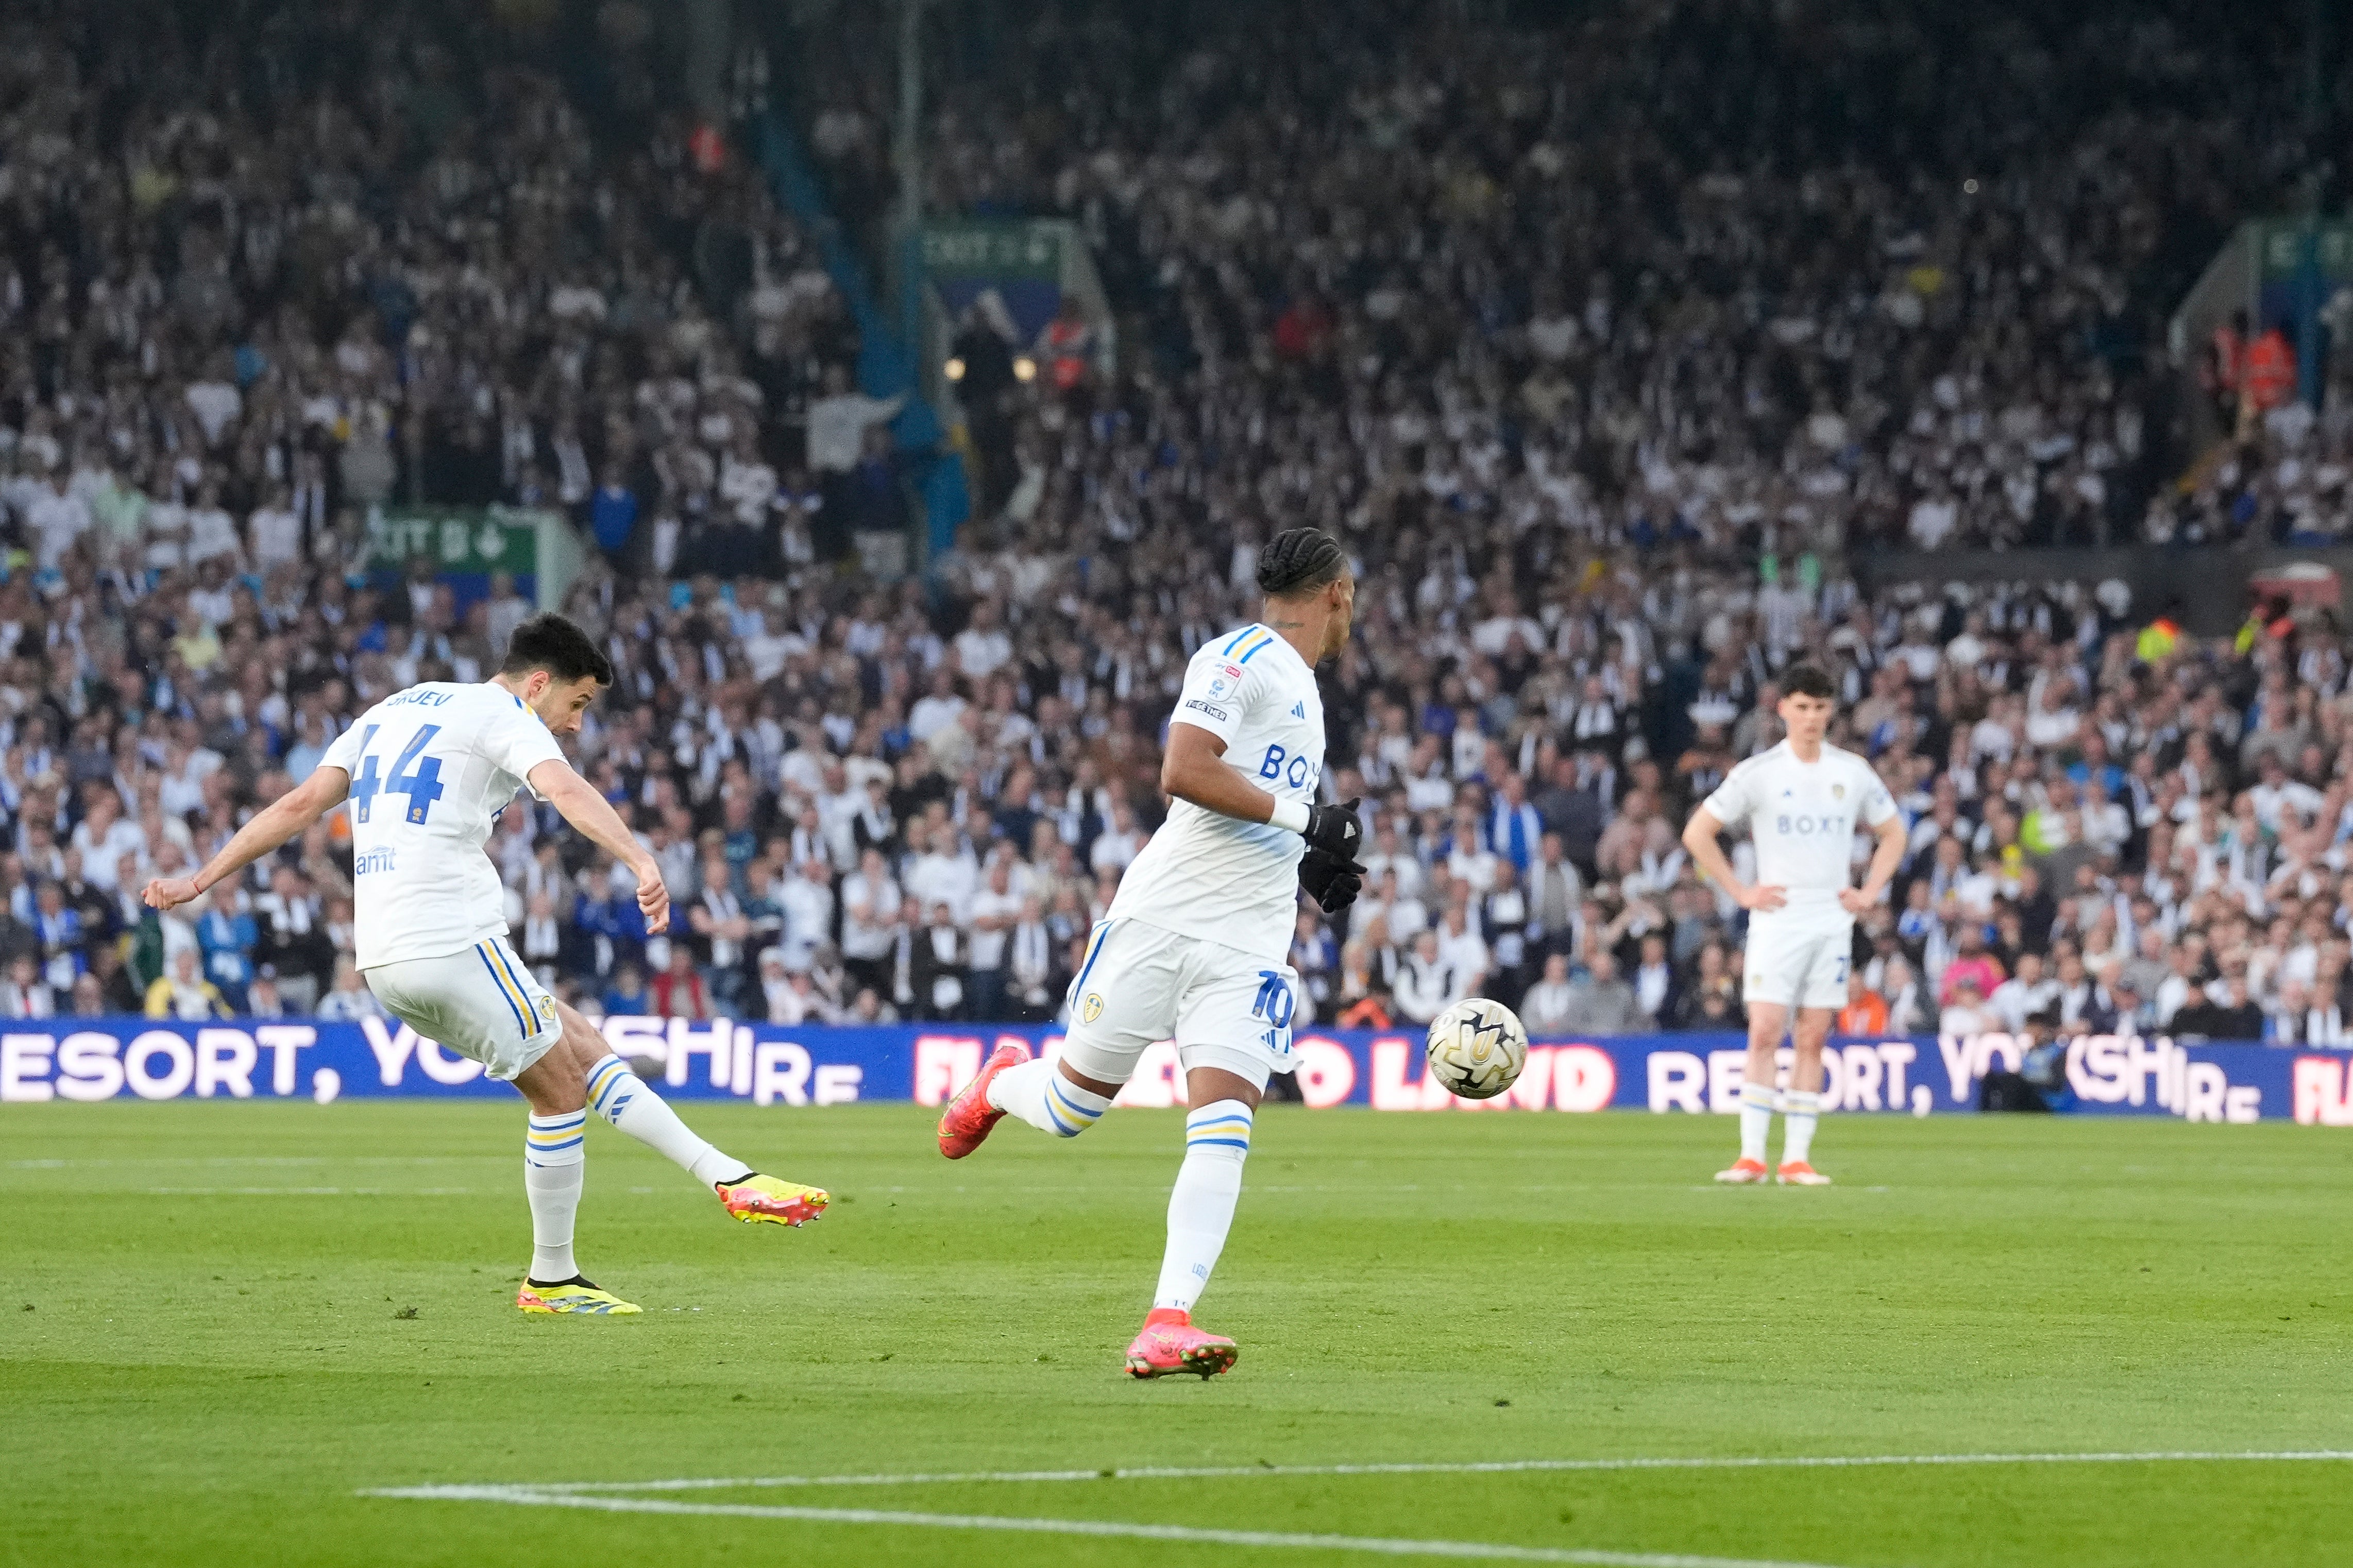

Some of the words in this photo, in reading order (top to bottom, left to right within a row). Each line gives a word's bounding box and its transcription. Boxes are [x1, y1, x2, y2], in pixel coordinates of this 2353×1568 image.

[350, 724, 444, 825] 44
[356, 847, 396, 875] amt
[1252, 970, 1293, 1029] 10
[0, 1025, 341, 1105] ESORT,
[358, 1015, 864, 1106] YOSHIRE
[1937, 1030, 2261, 1123] YOSHIRE
